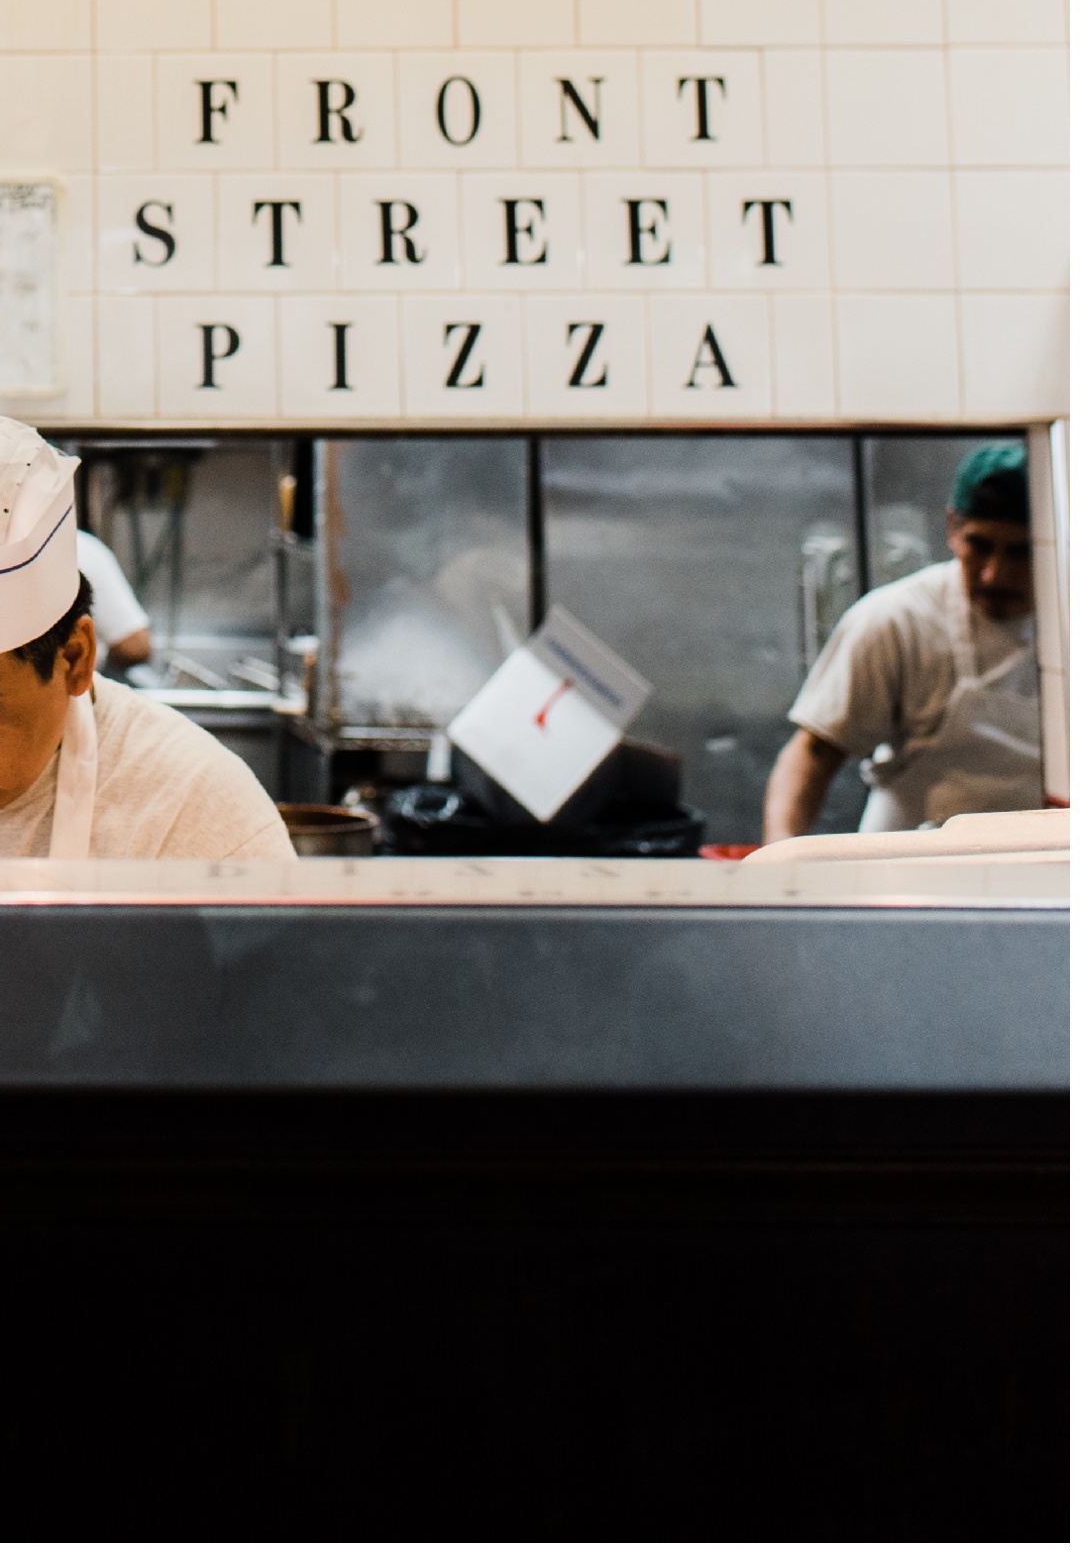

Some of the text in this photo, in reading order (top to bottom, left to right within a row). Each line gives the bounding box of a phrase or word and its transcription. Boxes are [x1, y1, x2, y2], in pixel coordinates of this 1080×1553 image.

[192, 75, 727, 148] FRONT
[131, 198, 793, 269] STREET
[193, 321, 740, 392] PIZZA
